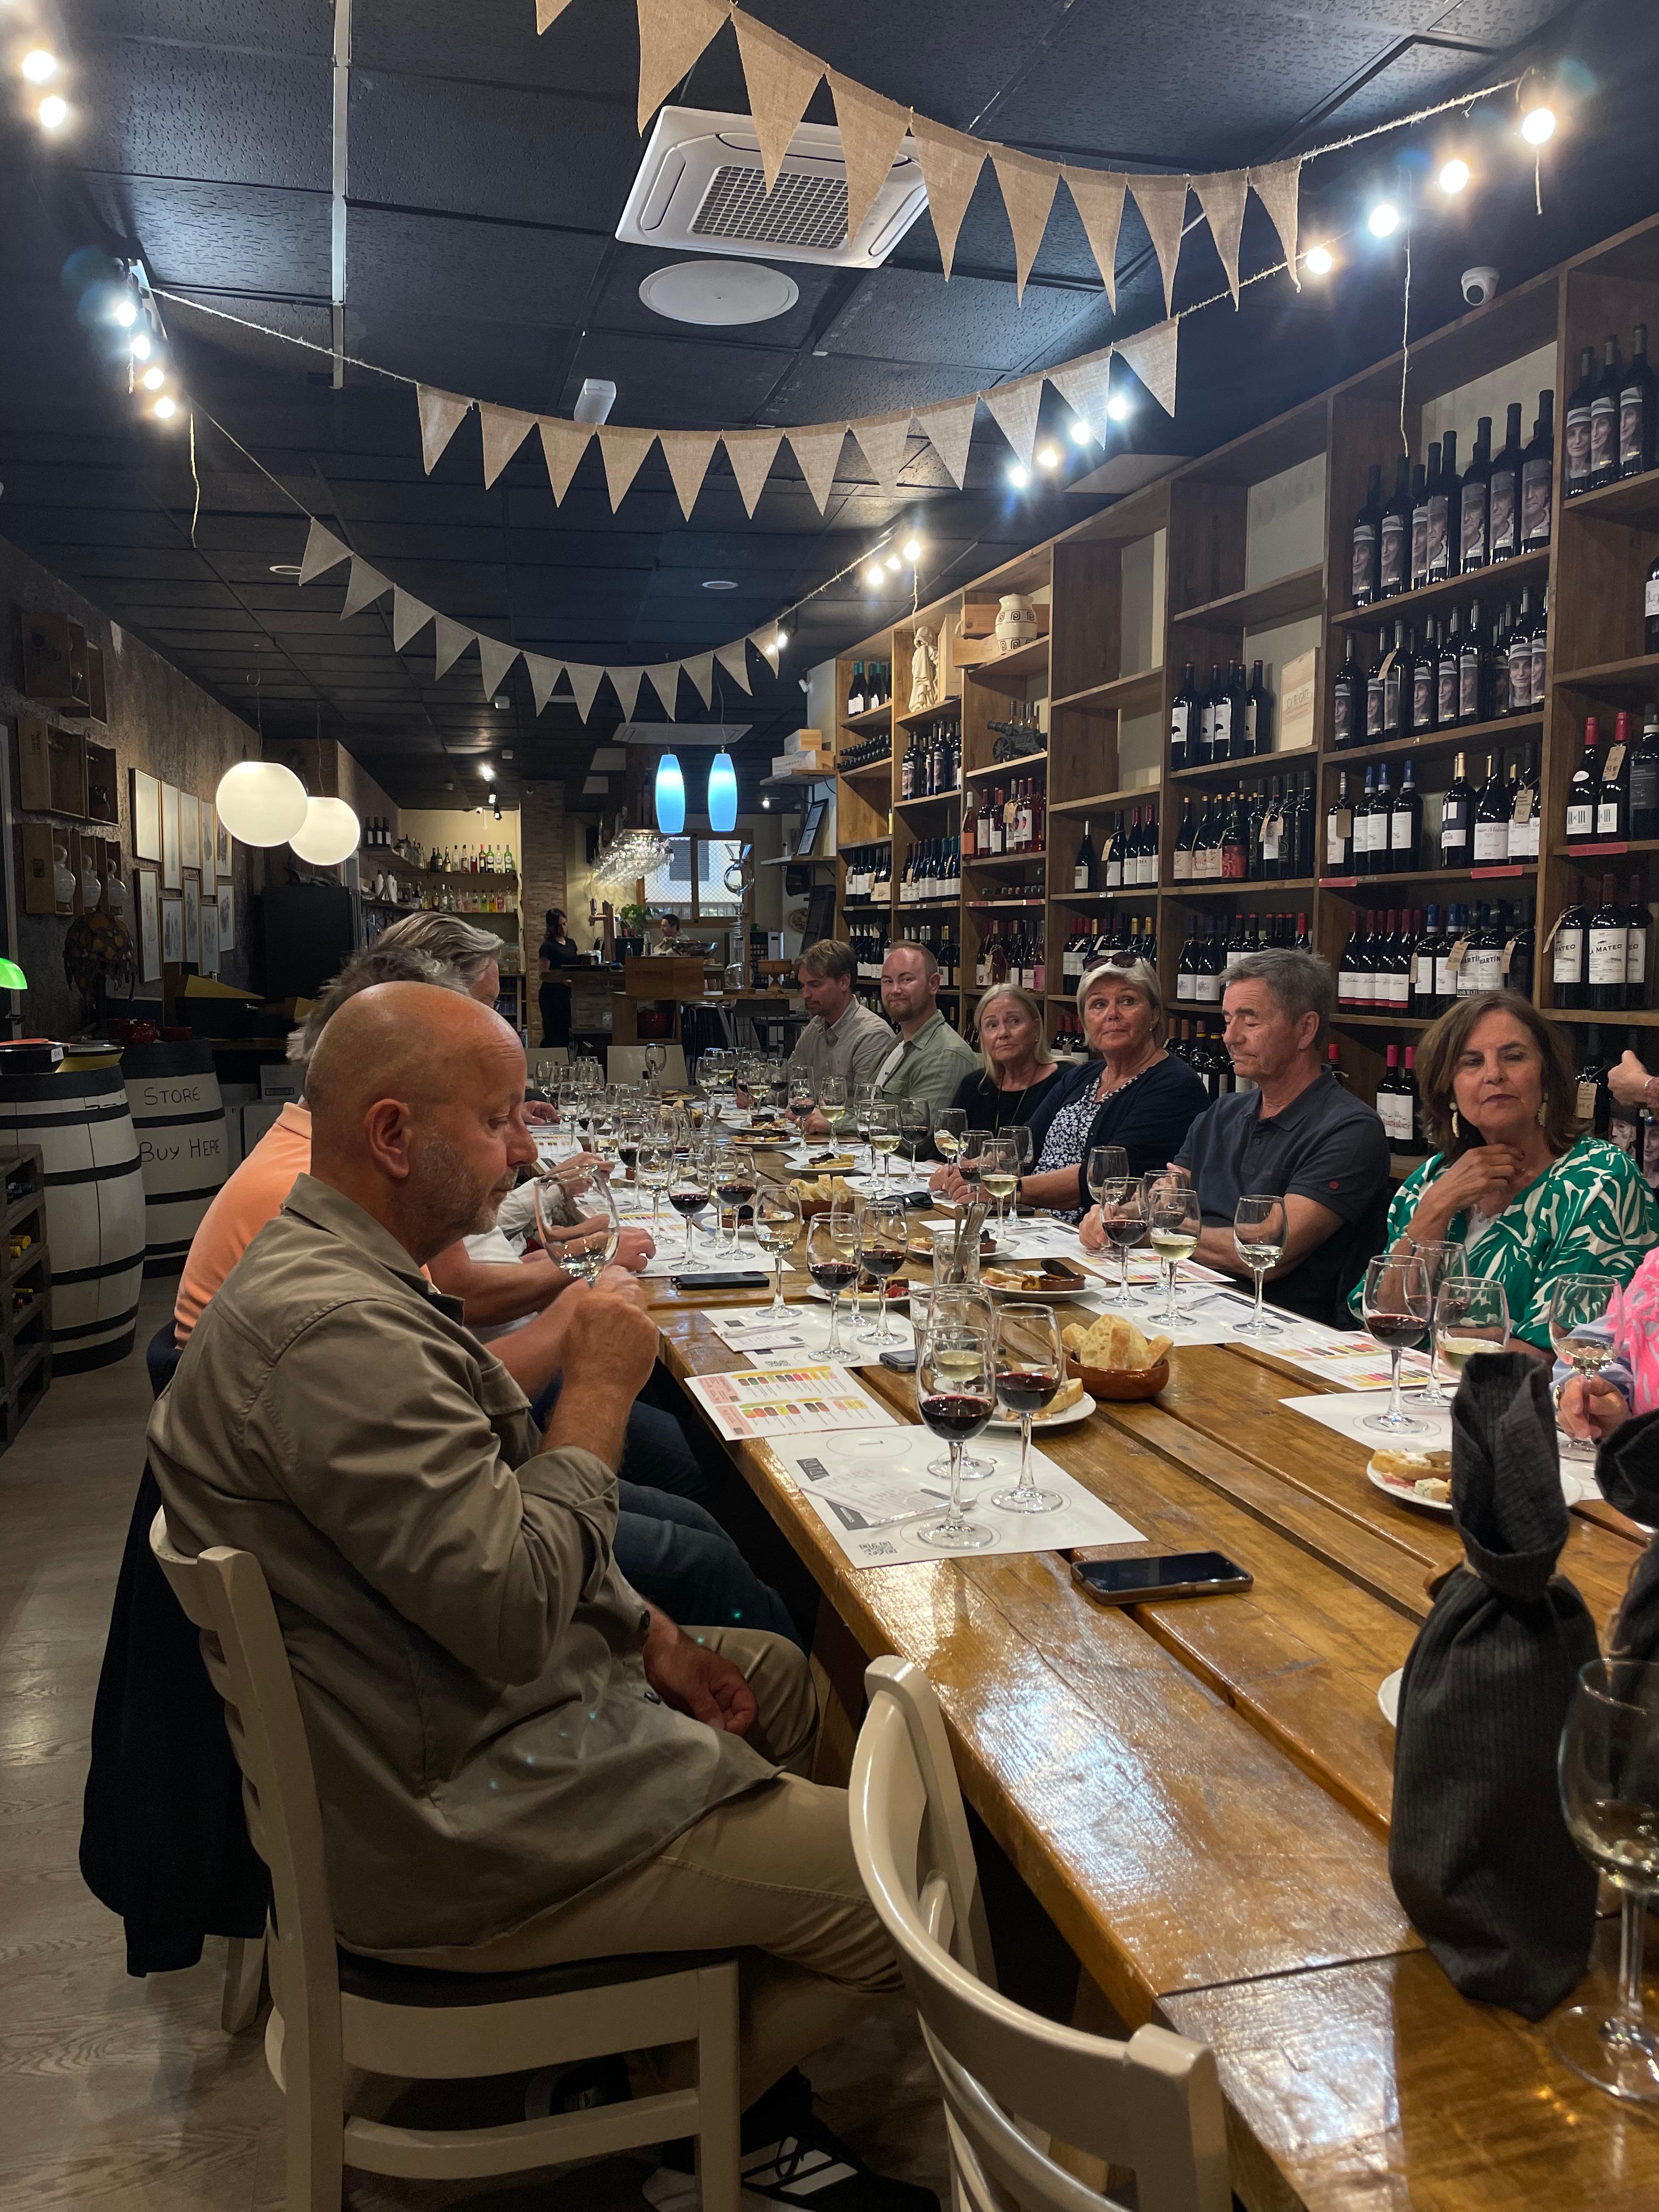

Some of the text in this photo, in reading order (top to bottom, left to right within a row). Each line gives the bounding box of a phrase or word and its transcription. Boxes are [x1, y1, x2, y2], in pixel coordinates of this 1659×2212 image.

[1596, 944, 1622, 953] MATEO
[144, 1087, 201, 1105] STORE
[189, 1138, 220, 1158] HERE
